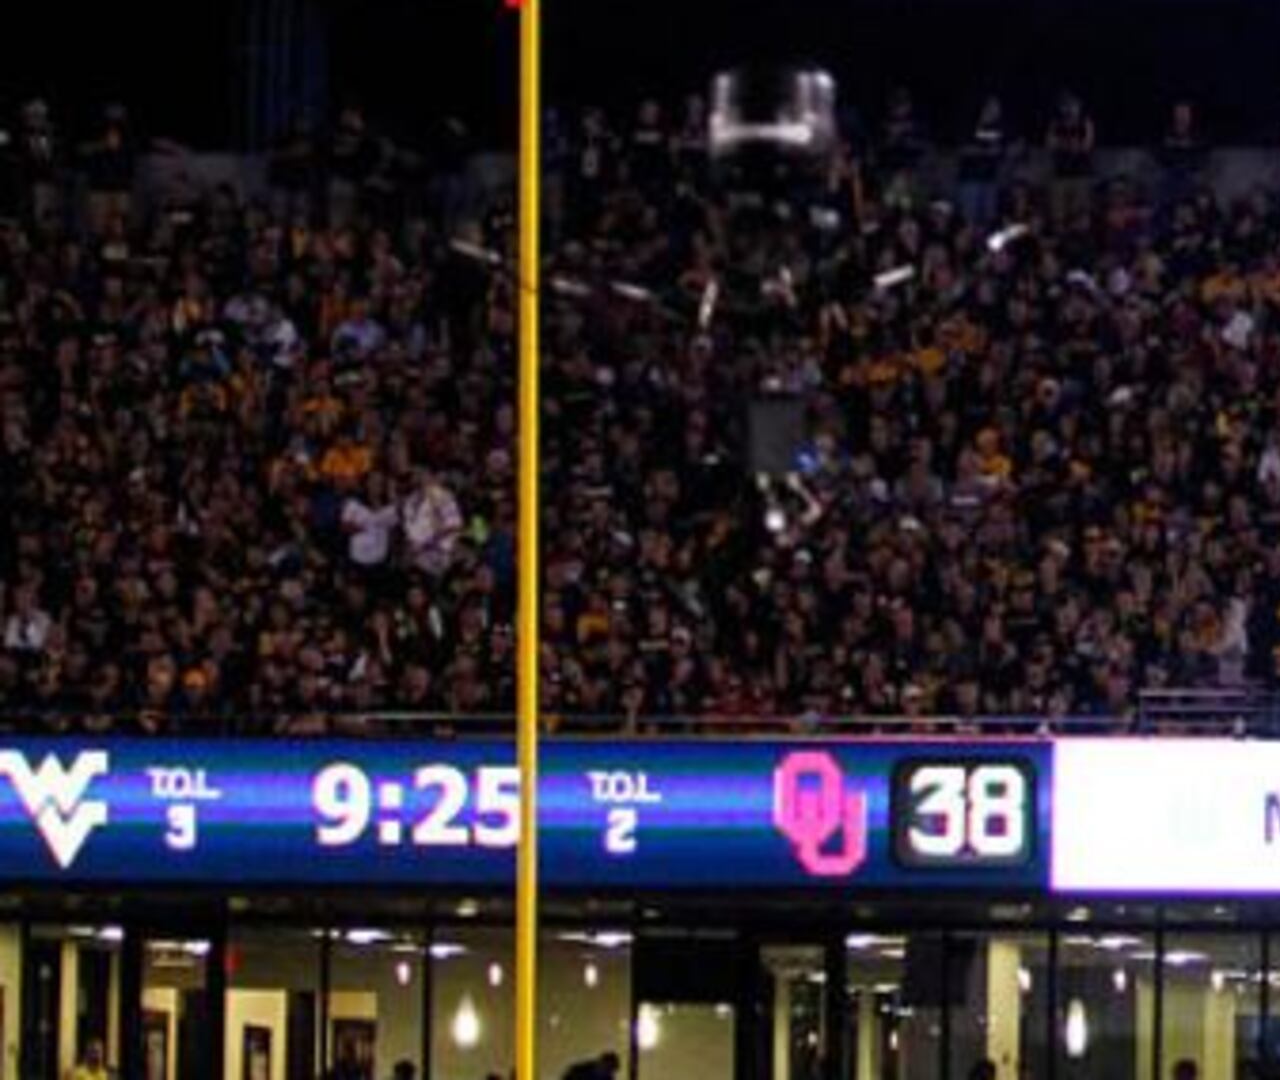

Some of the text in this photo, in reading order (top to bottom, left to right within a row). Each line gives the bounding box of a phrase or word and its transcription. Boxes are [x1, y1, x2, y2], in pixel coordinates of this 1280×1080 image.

[164, 804, 196, 850] 3
[311, 762, 522, 848] 9:25
[606, 809, 637, 854] 2
[908, 766, 1025, 856] 38
